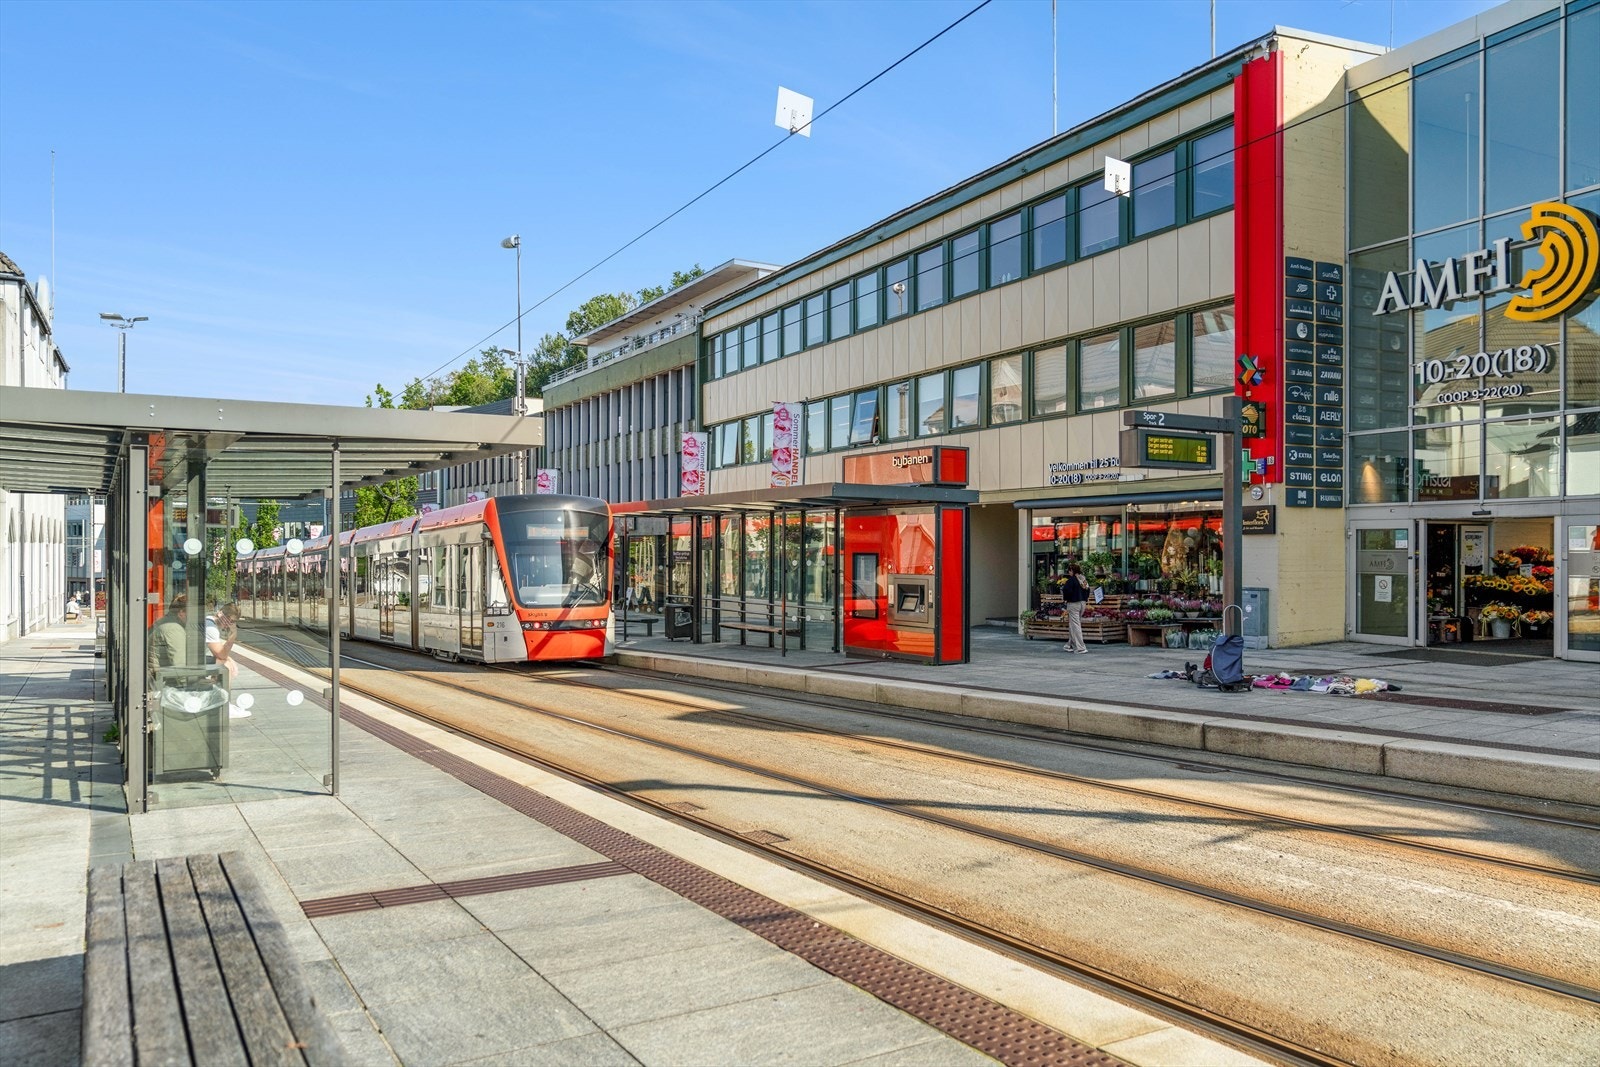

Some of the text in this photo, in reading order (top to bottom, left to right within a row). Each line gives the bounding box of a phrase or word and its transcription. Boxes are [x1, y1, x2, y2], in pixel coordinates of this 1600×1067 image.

[1372, 237, 1513, 315] AMFI
[1416, 343, 1548, 384] 10-20(18)
[1437, 384, 1523, 403] COOP 9-22(20)
[1143, 412, 1165, 425] Spor 2
[892, 455, 928, 468] bybanen
[1090, 459, 1098, 469] til
[1099, 457, 1110, 468] 25
[1290, 472, 1312, 481] STING
[1403, 467, 1451, 488] Bomster
